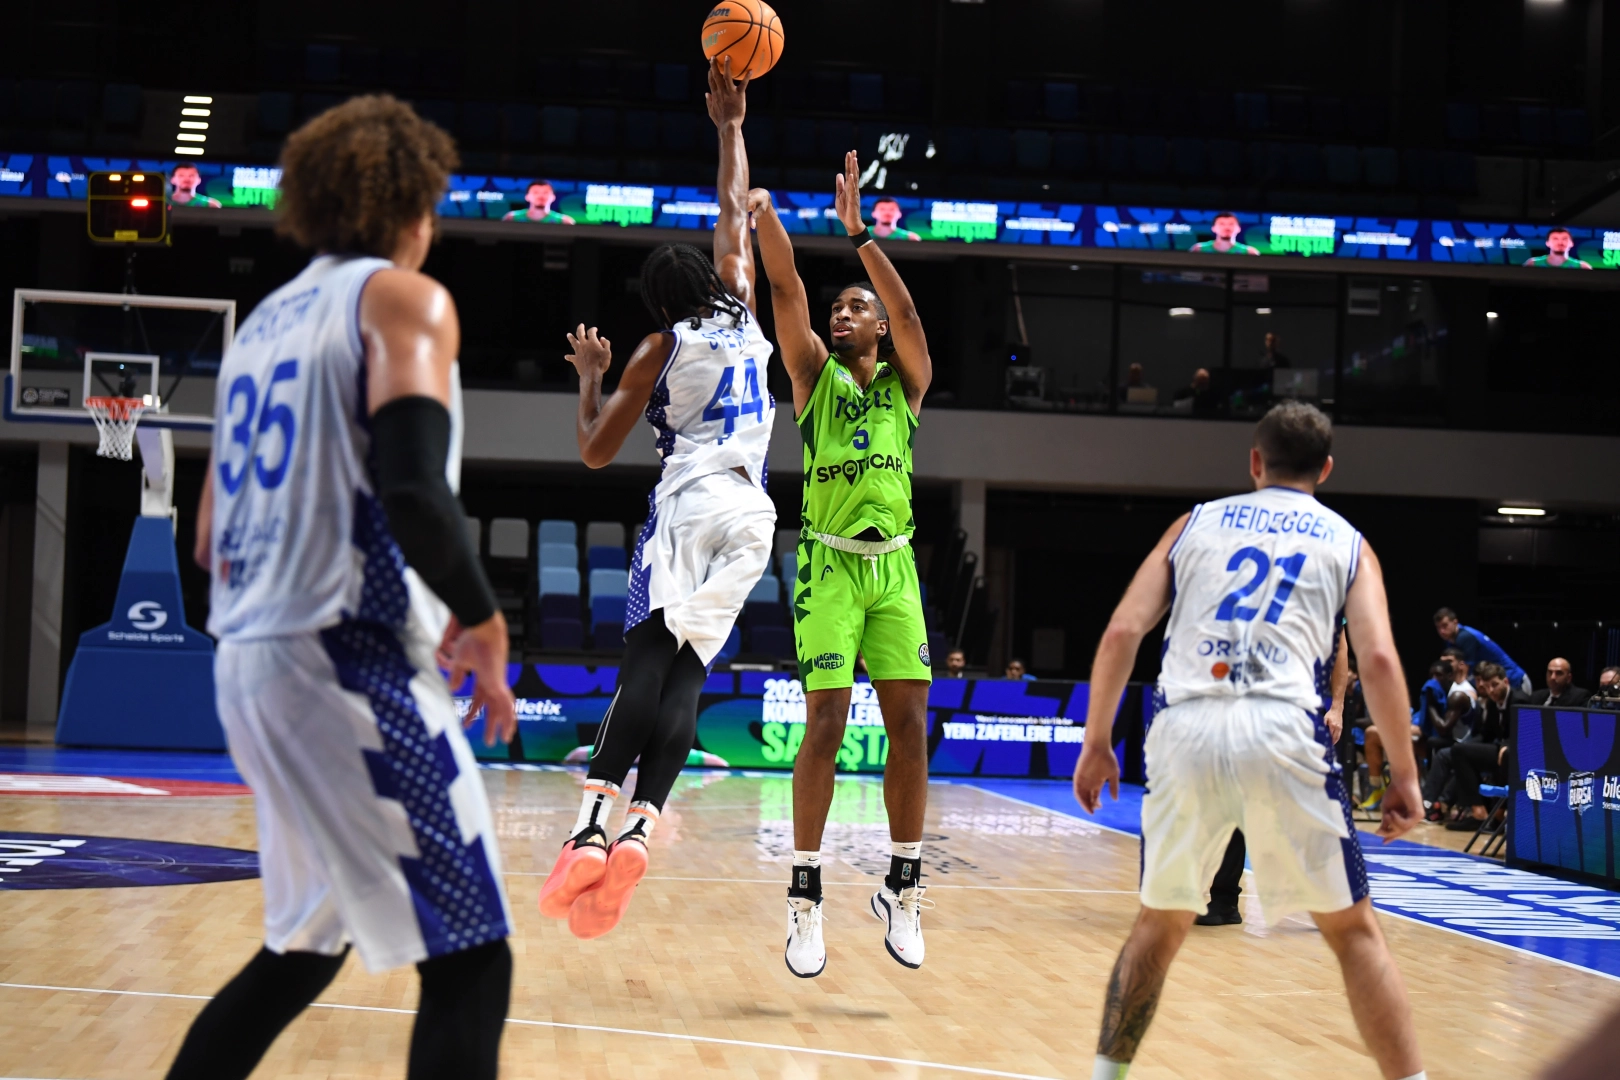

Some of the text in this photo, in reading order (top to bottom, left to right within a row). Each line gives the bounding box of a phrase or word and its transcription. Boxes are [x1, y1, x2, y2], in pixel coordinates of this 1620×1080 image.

[701, 357, 762, 434] 44
[218, 358, 298, 496] 35
[852, 429, 870, 450] 5
[1219, 504, 1341, 544] HEIDEGGER
[1215, 545, 1307, 625] 21
[150, 632, 185, 644] Sports
[511, 698, 562, 715] iletix
